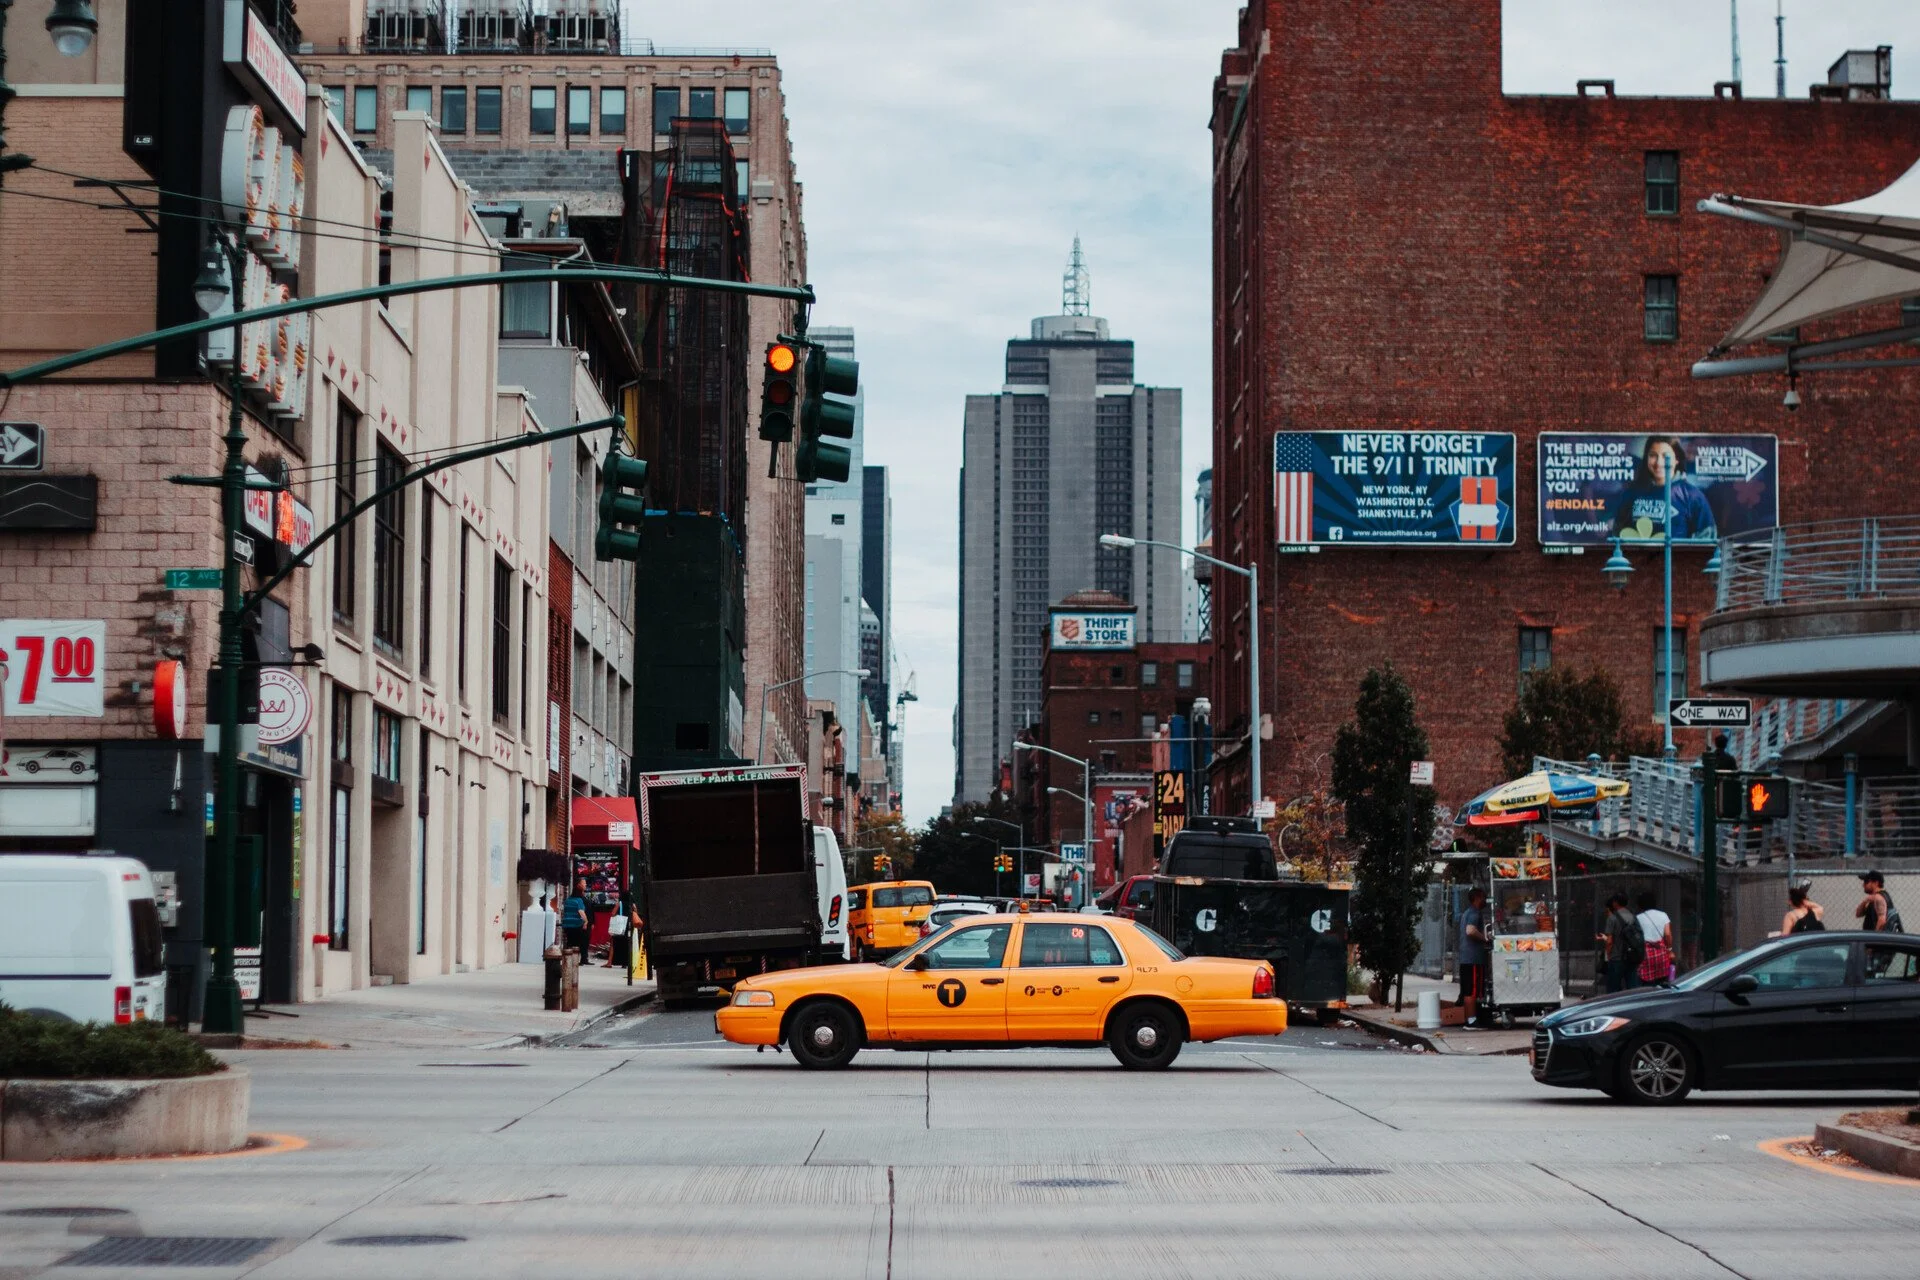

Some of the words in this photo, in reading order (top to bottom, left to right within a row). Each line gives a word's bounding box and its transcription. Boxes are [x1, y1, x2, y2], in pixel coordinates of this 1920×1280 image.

[1342, 434, 1405, 452] NEVER
[1410, 436, 1485, 453] FORGET
[1545, 443, 1572, 454] THE
[1575, 443, 1604, 454] END
[1607, 443, 1626, 454] OF
[1697, 446, 1727, 456] WALK
[1331, 456, 1368, 474] THE
[1373, 457, 1414, 474] 9/11
[1423, 457, 1497, 475] TRINITY
[1545, 456, 1633, 467] ALZHEIMER'S
[1699, 457, 1742, 466] END
[1546, 469, 1596, 480] STARTS
[1598, 469, 1634, 480] WITH
[1363, 486, 1385, 494] NEW
[1387, 486, 1414, 496] YORK,
[1416, 486, 1428, 495] NY
[1546, 481, 1579, 493] YOU.
[1356, 497, 1415, 507] WASHINGTON
[1417, 498, 1434, 507] D.C.
[1546, 499, 1605, 509] #ENDALZ
[1357, 509, 1419, 519] SHANKSVILLE,
[1421, 510, 1433, 518] PA
[1547, 521, 1608, 533] alz.org/walk
[172, 572, 190, 587] 12
[197, 571, 216, 580] AVE
[1084, 618, 1129, 628] THRIFT
[1085, 630, 1128, 640] STORE
[1680, 707, 1704, 718] ONE
[1718, 708, 1744, 718] WAY
[259, 726, 292, 737] ONUTS
[681, 776, 706, 785] KEEP
[738, 771, 772, 782] CLEAN
[1162, 772, 1184, 804] 24
[1500, 794, 1538, 806] SABRETT
[944, 984, 960, 1004] T
